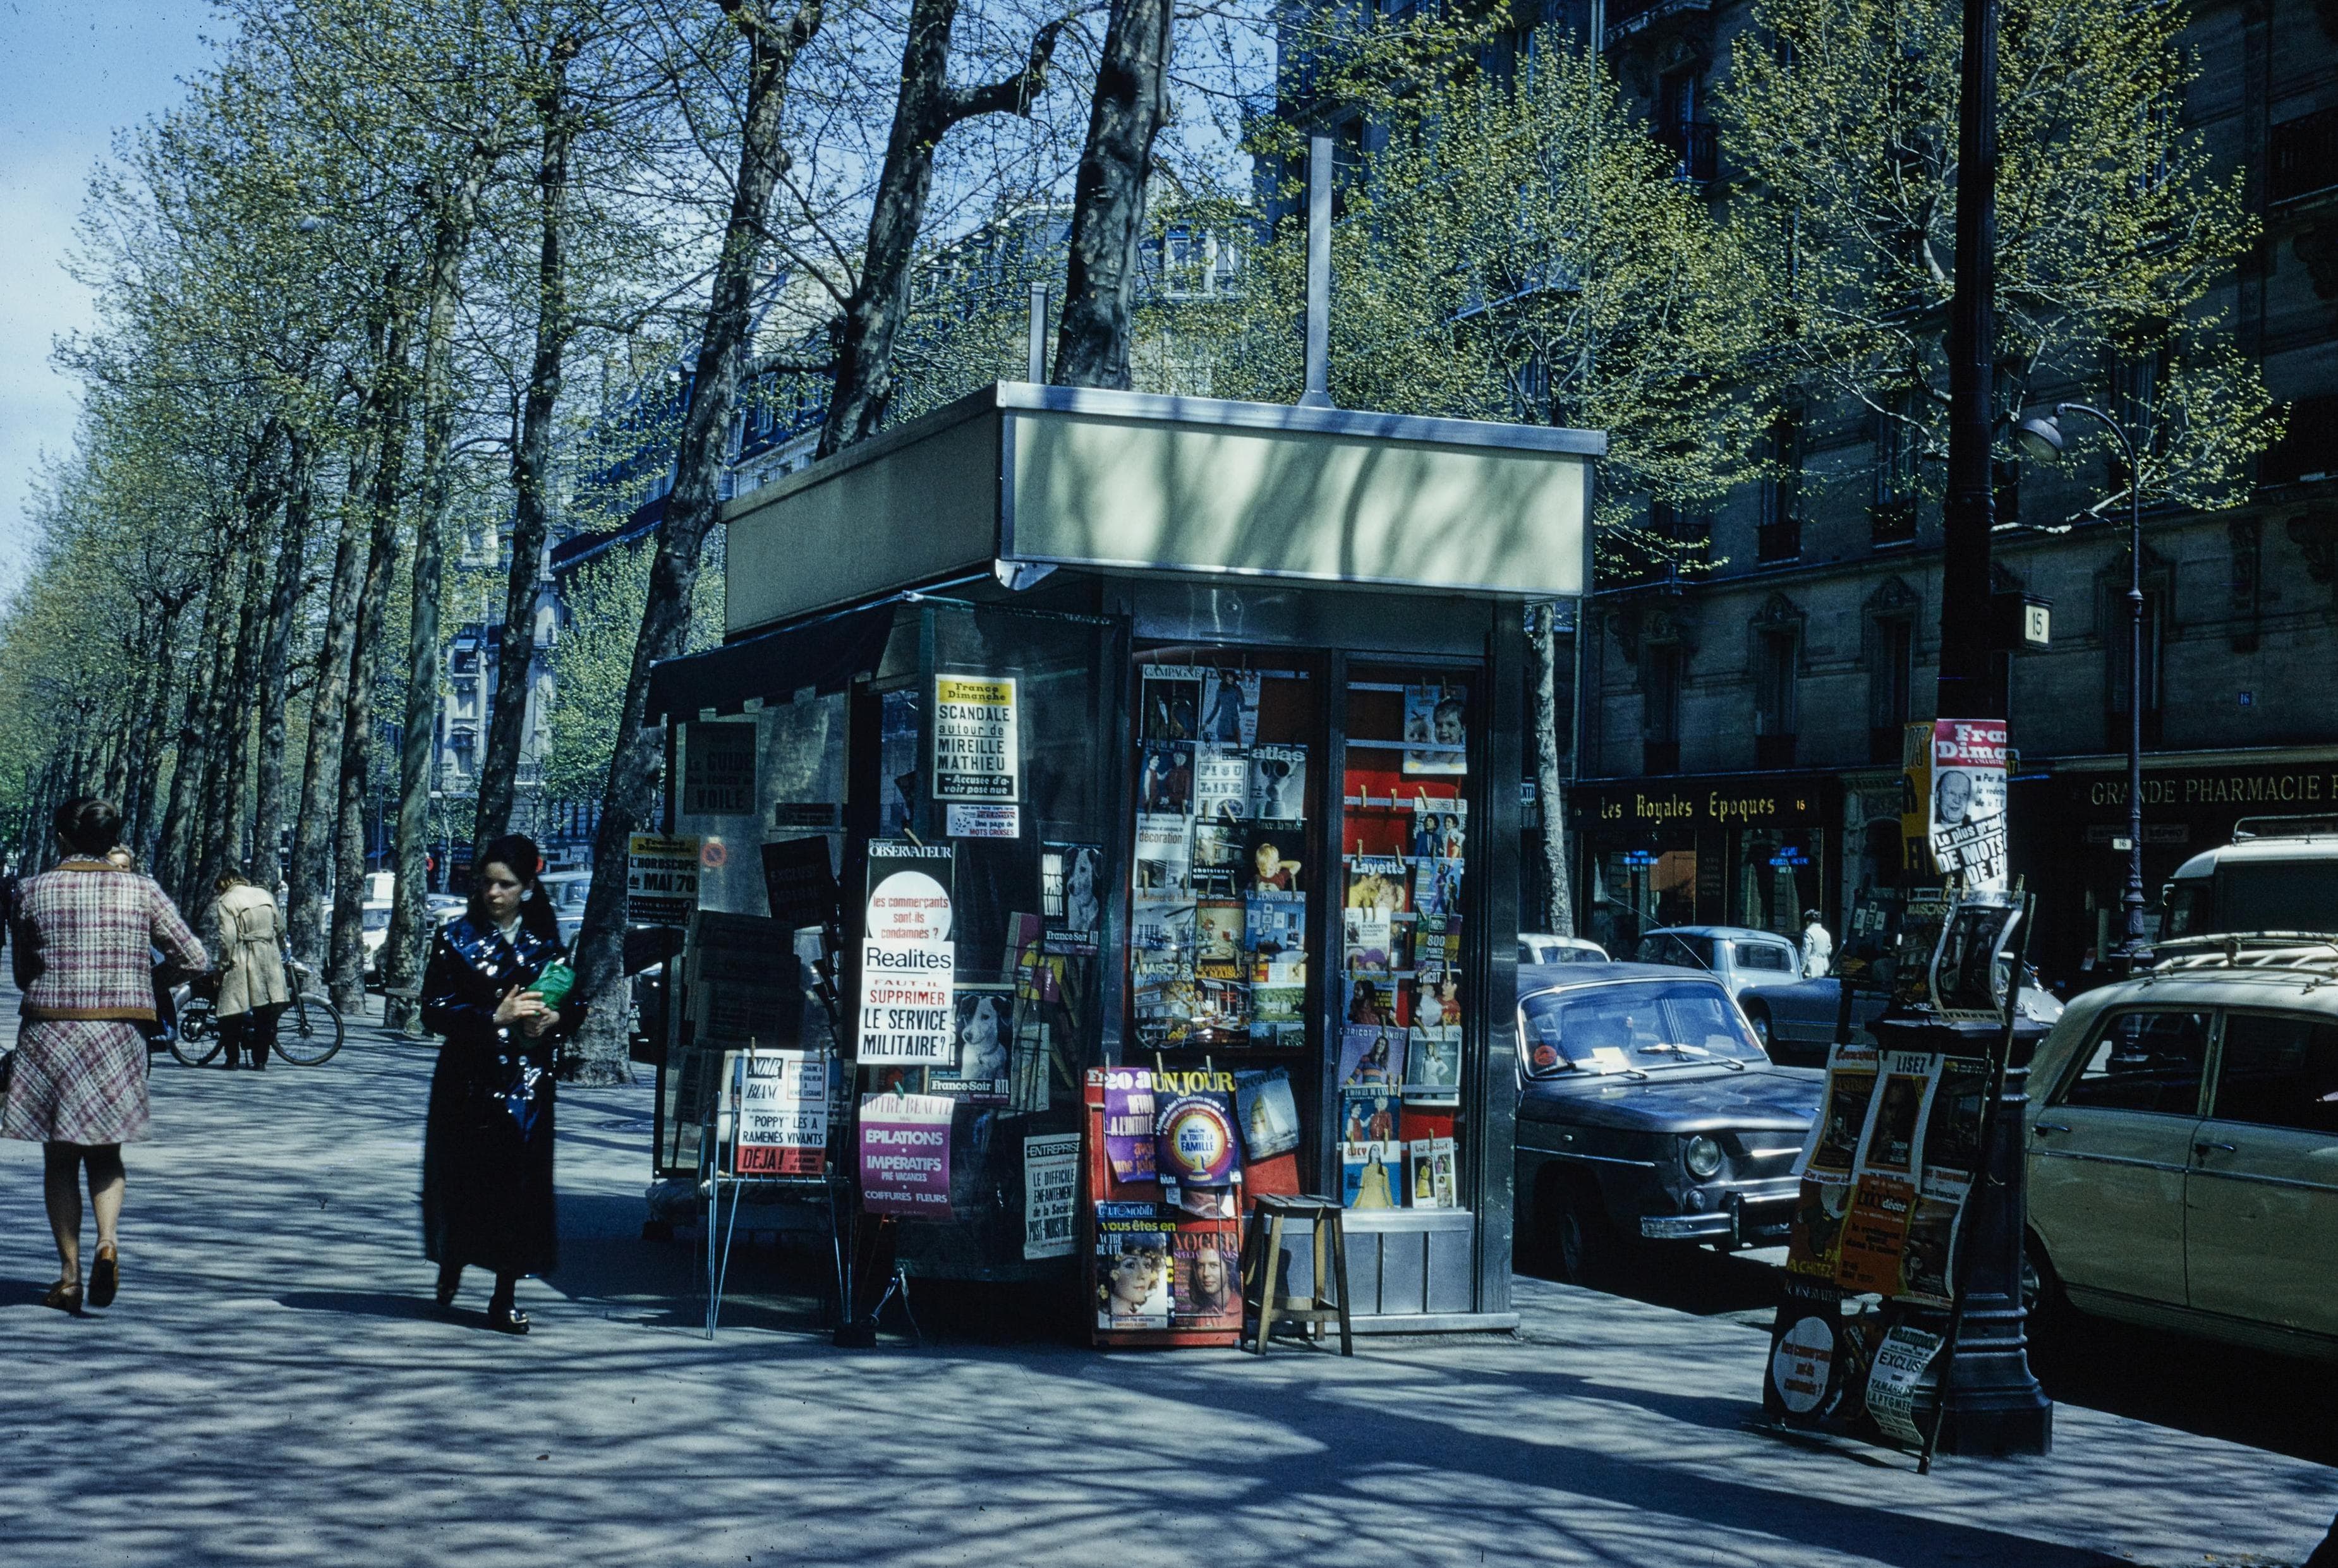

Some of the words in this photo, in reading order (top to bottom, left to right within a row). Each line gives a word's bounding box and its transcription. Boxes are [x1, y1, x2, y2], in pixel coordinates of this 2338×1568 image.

[2032, 613, 2043, 636] 15
[955, 682, 998, 692] France
[948, 691, 1006, 701] Dimanche
[939, 705, 1010, 721] SCANDALE
[939, 723, 984, 735] autour
[990, 724, 1004, 736] de
[938, 739, 1004, 754] MIREILLE
[1251, 746, 1306, 762] atlas
[938, 756, 1005, 771] MATHIEU
[952, 774, 990, 784] Accusée
[944, 783, 965, 793] voir
[2186, 775, 2320, 804] PHARMACIE
[1601, 797, 1621, 819] Les
[1637, 794, 1692, 824] Royales
[1139, 830, 1182, 845] décoration
[1953, 822, 1975, 845] plus
[869, 845, 952, 858] OBSERVATEUR
[2119, 840, 2128, 848] 16
[1936, 850, 1961, 873] DE
[1961, 835, 2004, 866] MOTS
[629, 857, 697, 871] L'HOROSCOPE
[1351, 859, 1406, 876] Layette
[1965, 862, 1989, 885] DE
[644, 873, 673, 891] MAI
[676, 875, 696, 892] 70
[873, 896, 885, 907] les
[888, 896, 948, 909] commerçants
[1427, 935, 1445, 946] 800
[870, 989, 945, 1006] SUPPRIMER
[864, 1008, 881, 1028] LE
[888, 1009, 948, 1031] SERVICE
[1347, 1027, 1372, 1037] TRICOT
[748, 1058, 782, 1076] NOIR
[1896, 1055, 1927, 1072] LISEZ
[931, 1080, 991, 1091] France-Soir
[995, 1078, 1010, 1094] RTL
[1105, 1071, 1134, 1090] 20
[1150, 1071, 1178, 1094] UN
[1177, 1071, 1237, 1097] JOUR
[746, 1083, 782, 1100] BLANC
[863, 1094, 902, 1114] VOTRE
[794, 1117, 808, 1129] LES
[811, 1118, 818, 1130] A
[743, 1130, 784, 1143] RAMENÉS
[787, 1133, 823, 1145] VIVANTS
[1180, 1141, 1214, 1152] FAMILLE
[895, 1173, 928, 1183] VACANCES
[1033, 1173, 1041, 1187] LE
[1045, 1168, 1074, 1186] DIFFICILE
[1160, 1175, 1176, 1185] MAI
[864, 1190, 912, 1202] COIFFURES
[916, 1193, 948, 1203] FLEURS
[1033, 1207, 1041, 1218] de
[1044, 1205, 1049, 1216] la
[1102, 1221, 1130, 1232] vous
[1132, 1219, 1158, 1232] êtes
[1160, 1221, 1177, 1232] en
